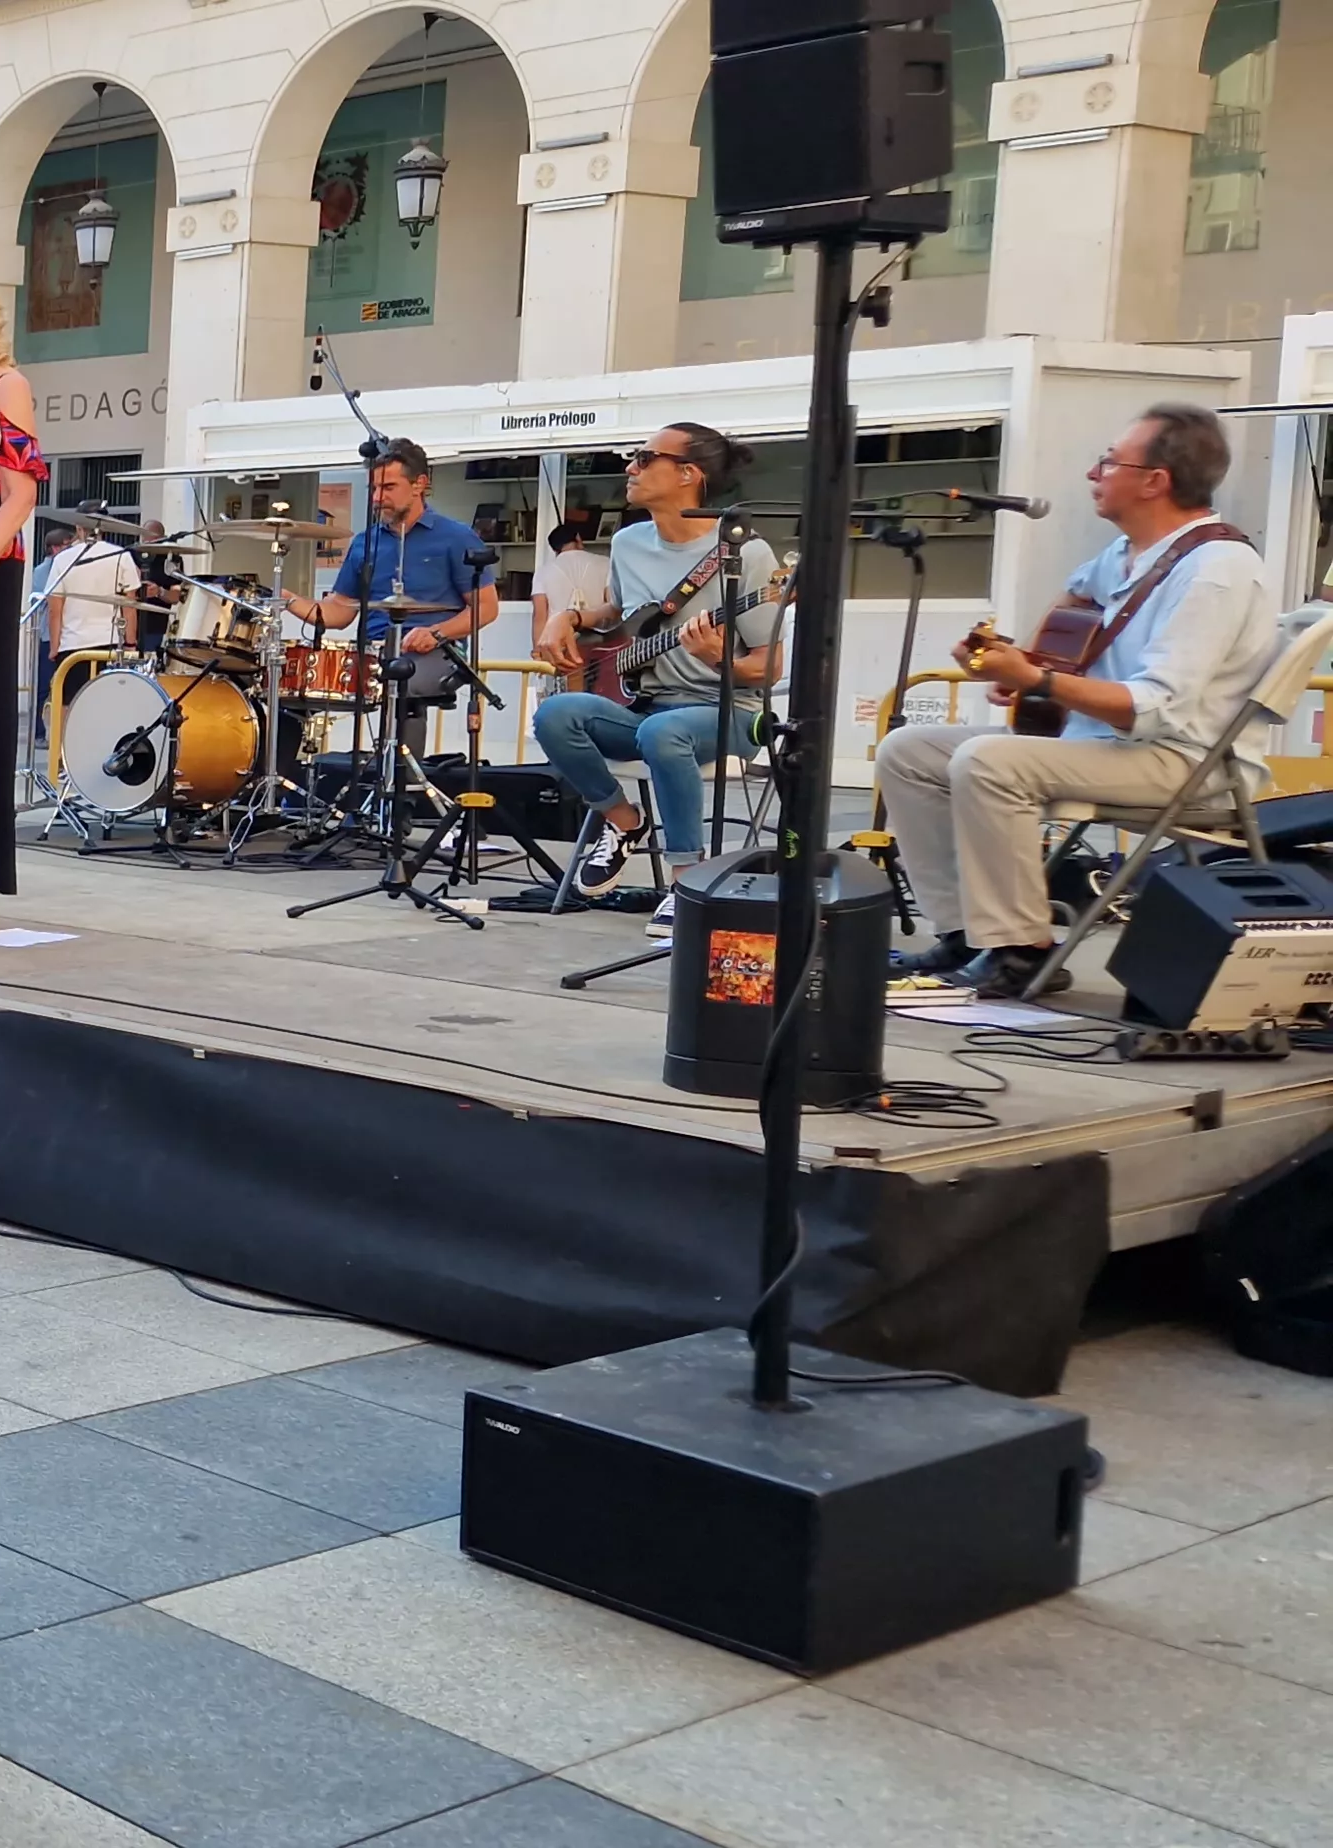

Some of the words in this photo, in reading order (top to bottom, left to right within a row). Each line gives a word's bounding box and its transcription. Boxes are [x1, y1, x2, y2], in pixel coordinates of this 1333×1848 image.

[378, 297, 424, 310] GOBIERNO
[378, 310, 389, 320] DE
[32, 378, 168, 422] EDAGÓ
[501, 413, 546, 430] Librería
[548, 411, 596, 427] Prólogo
[906, 713, 969, 726] ARAGN
